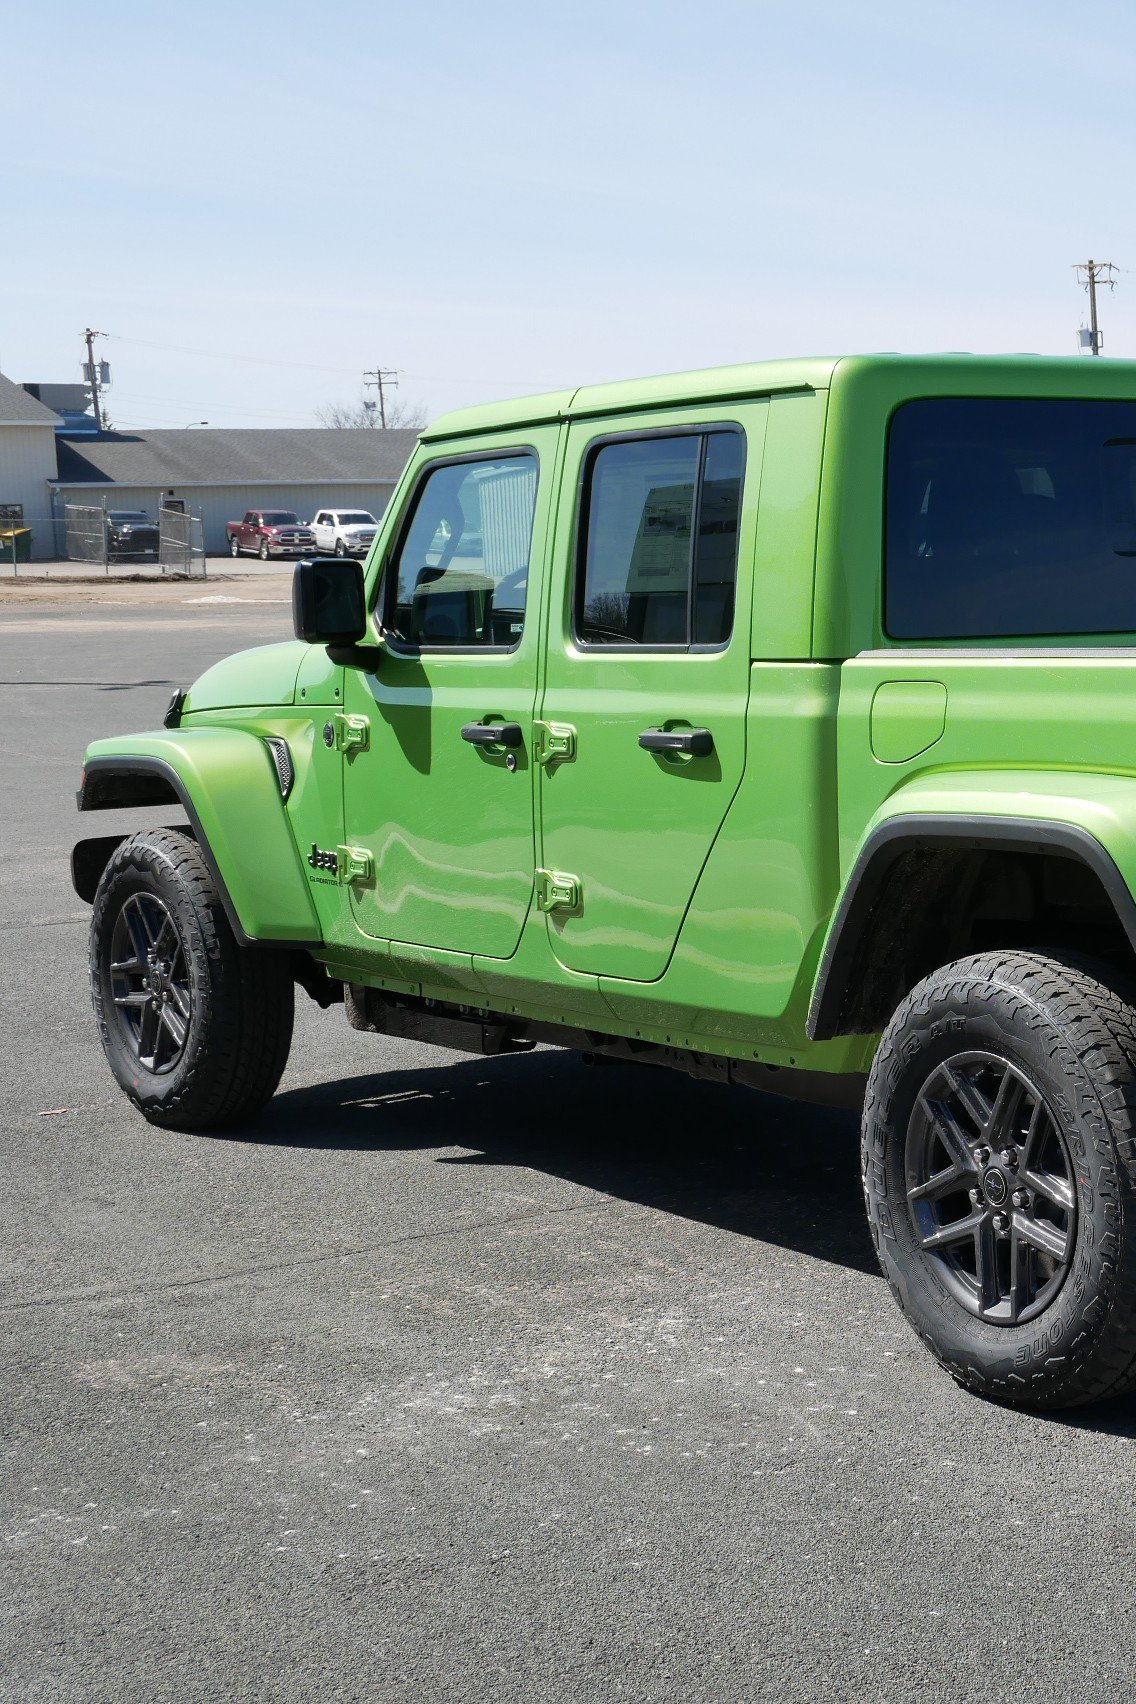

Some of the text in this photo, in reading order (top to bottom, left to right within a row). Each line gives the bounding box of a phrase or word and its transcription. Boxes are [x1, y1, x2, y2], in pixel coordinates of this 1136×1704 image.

[307, 843, 338, 878] Jeep
[310, 876, 338, 887] GLADIATOR
[930, 1015, 967, 1041] A/T
